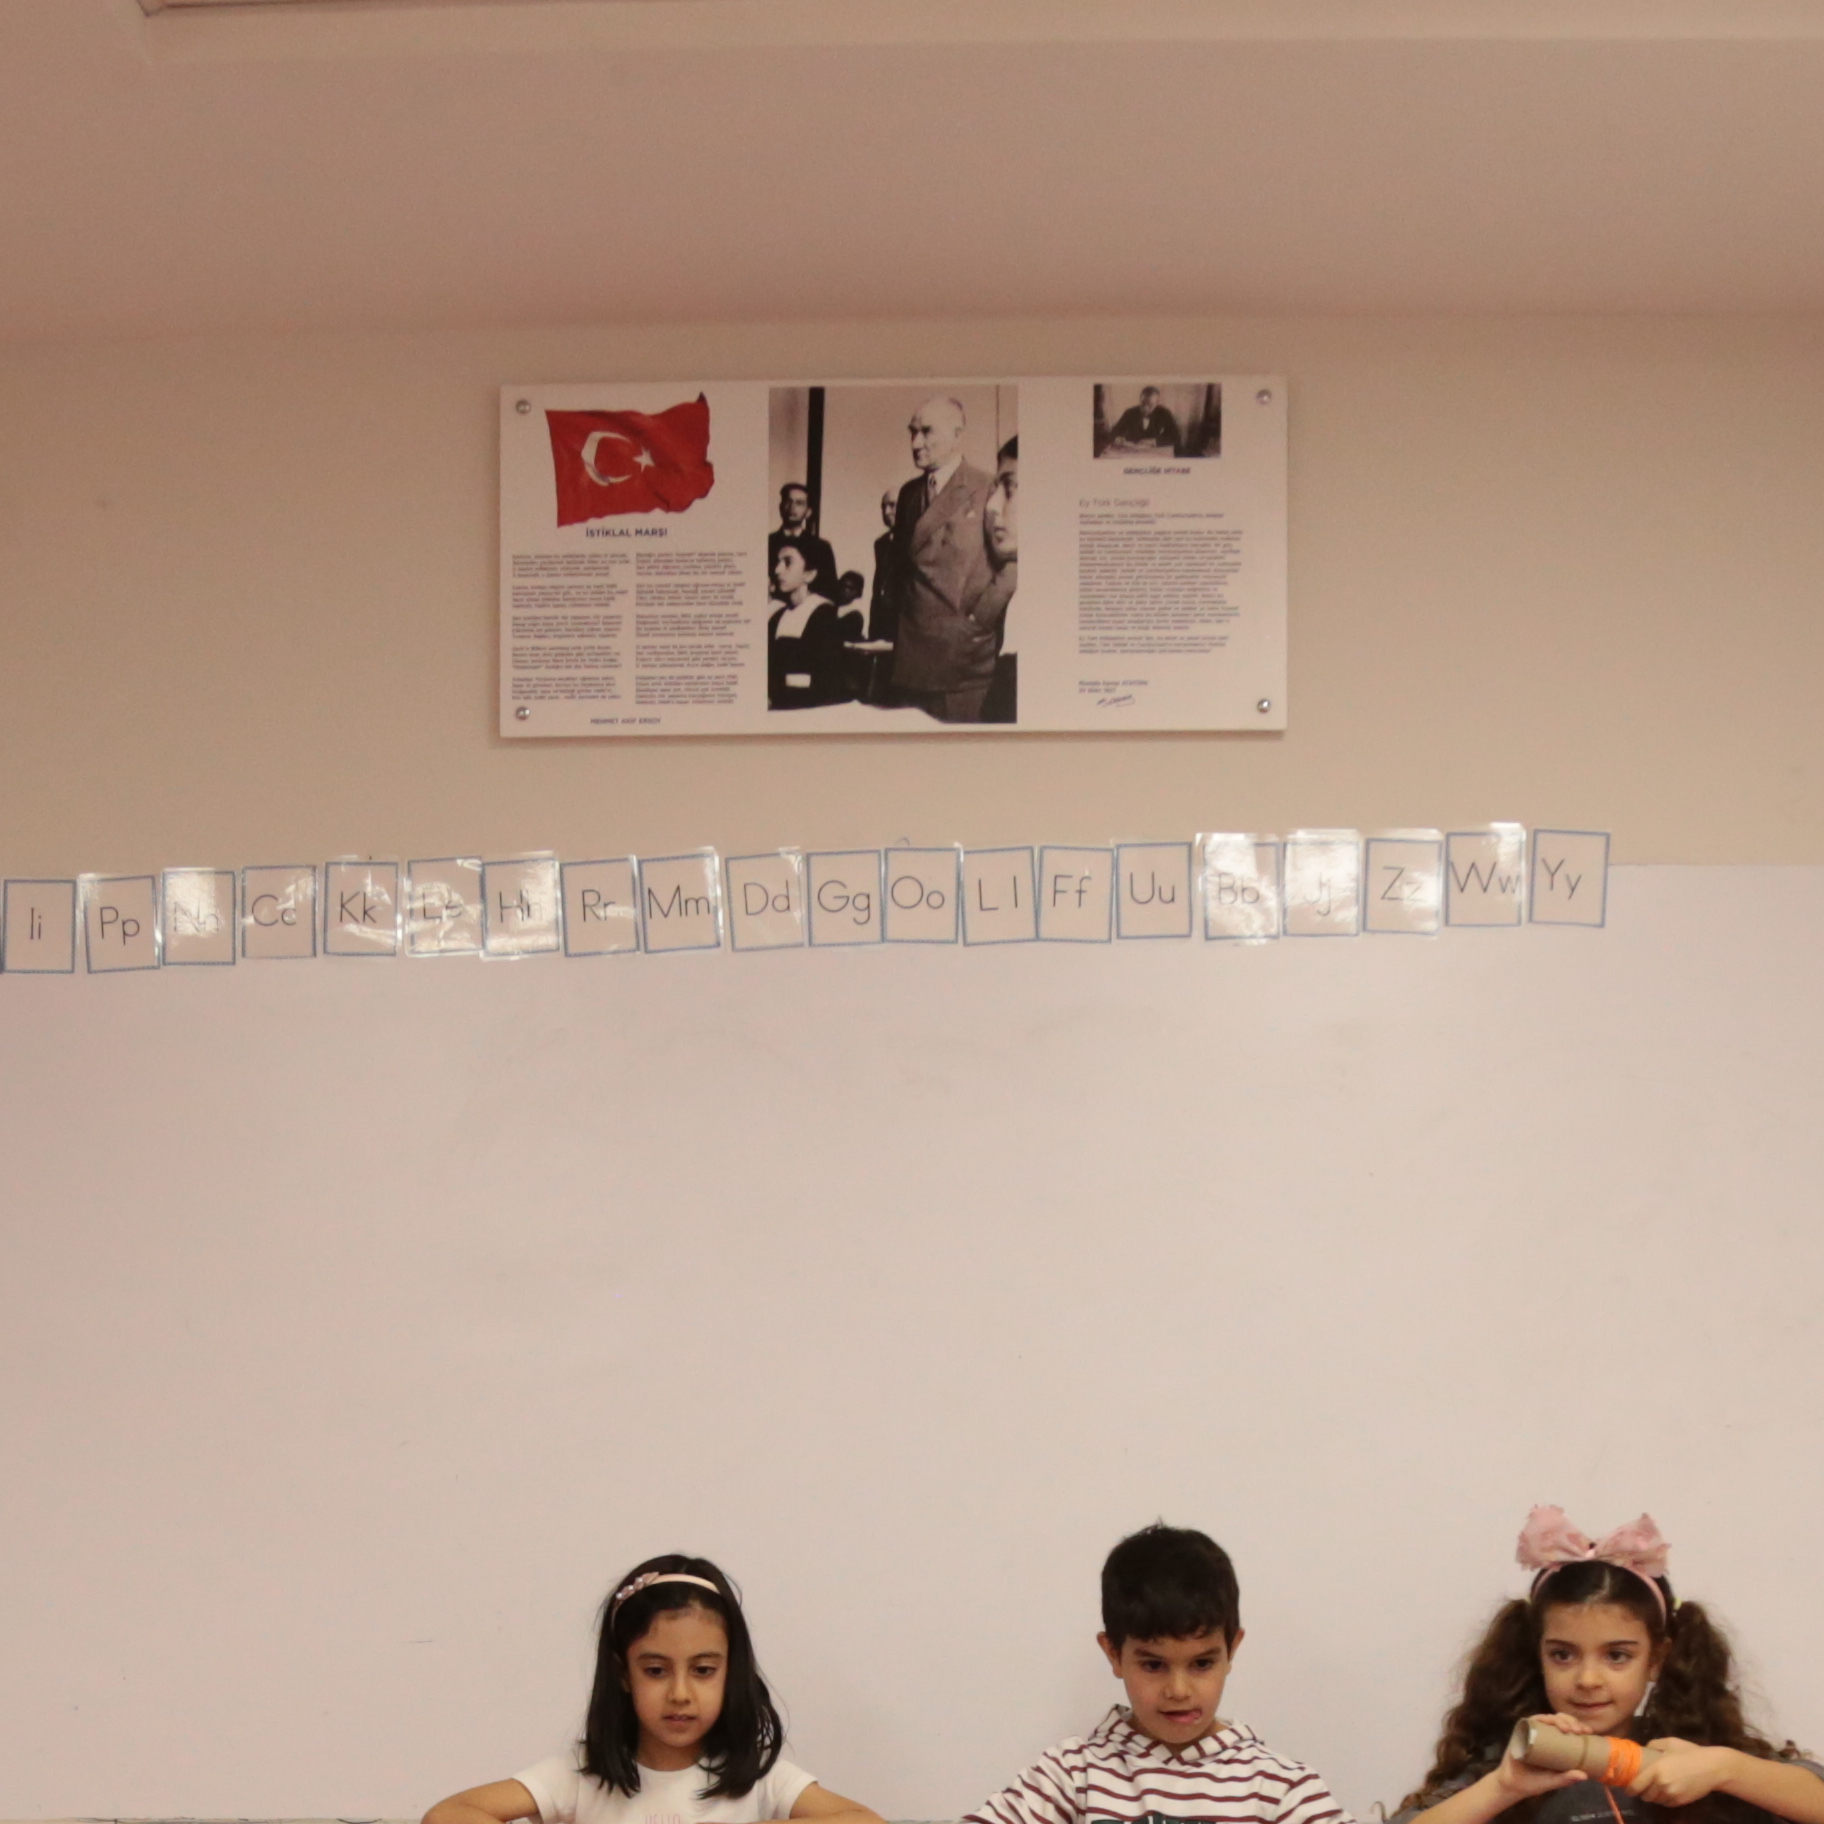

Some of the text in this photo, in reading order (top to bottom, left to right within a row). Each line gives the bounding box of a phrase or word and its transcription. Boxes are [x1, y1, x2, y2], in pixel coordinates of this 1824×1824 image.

[586, 528, 668, 538] İSTİKLAL MARŞI
[98, 906, 141, 946] Pp
[251, 894, 297, 927] Cc
[339, 890, 378, 923] Kk
[581, 889, 616, 923] Rr
[647, 884, 711, 920] Mm
[743, 880, 791, 917] Dd
[817, 879, 871, 925] Gg
[890, 875, 946, 909] Oo
[1052, 874, 1093, 909] Ff
[1129, 871, 1176, 905] Uu
[1217, 872, 1261, 906] Bb
[1380, 865, 1422, 902] Zz
[1449, 860, 1521, 896] Ww
[1542, 857, 1583, 901] Yy
